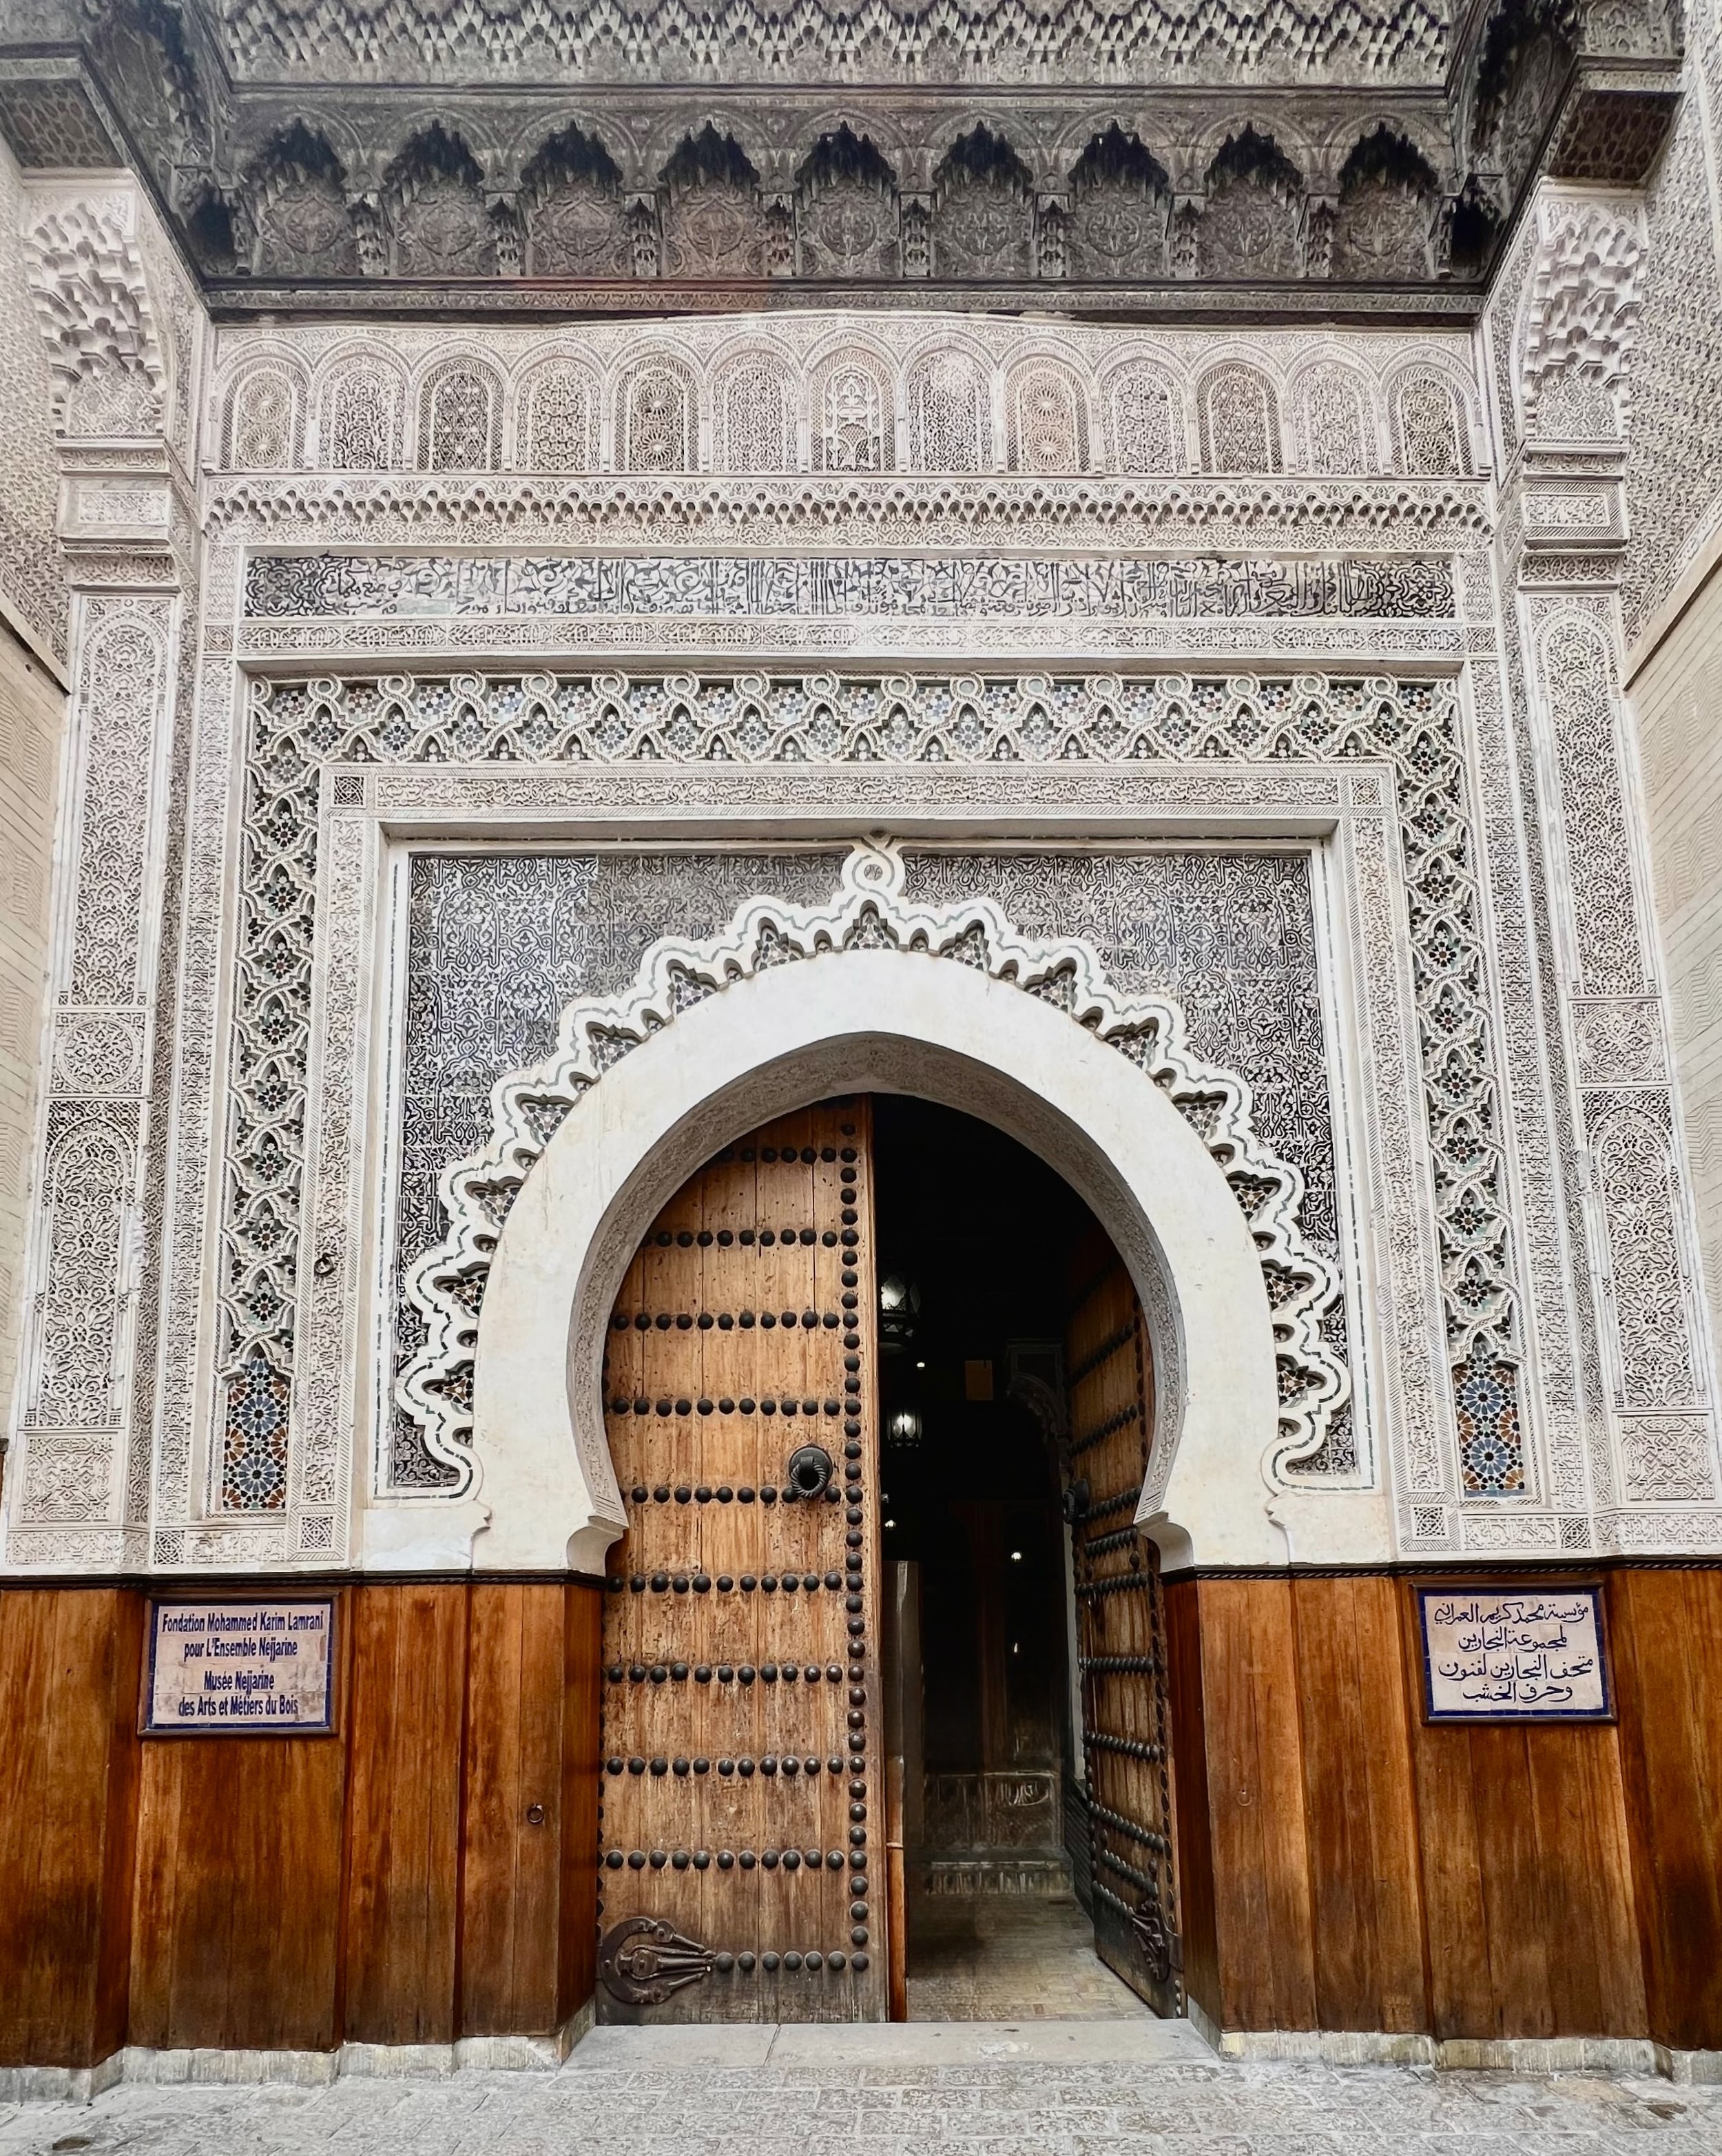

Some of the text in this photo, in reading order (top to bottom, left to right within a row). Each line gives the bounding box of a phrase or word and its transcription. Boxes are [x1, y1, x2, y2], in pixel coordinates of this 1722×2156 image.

[163, 1610, 323, 1632] Fondation Mohammed Karim Lamrani
[1481, 1602, 1524, 1625] كريم
[1511, 1604, 1544, 1624] محمد
[1544, 1602, 1588, 1624] مؤسسة
[184, 1641, 204, 1662] pour
[259, 1637, 298, 1661] Nejjarine
[1458, 1625, 1568, 1653] لمجموعة النجارين
[1438, 1653, 1594, 1681] متحف النجارين لفنون
[204, 1670, 274, 1694] Musée Nejjarine
[1462, 1681, 1573, 1703] وحرف الخشب
[178, 1694, 298, 1717] des Arts et Métiers du Bois
